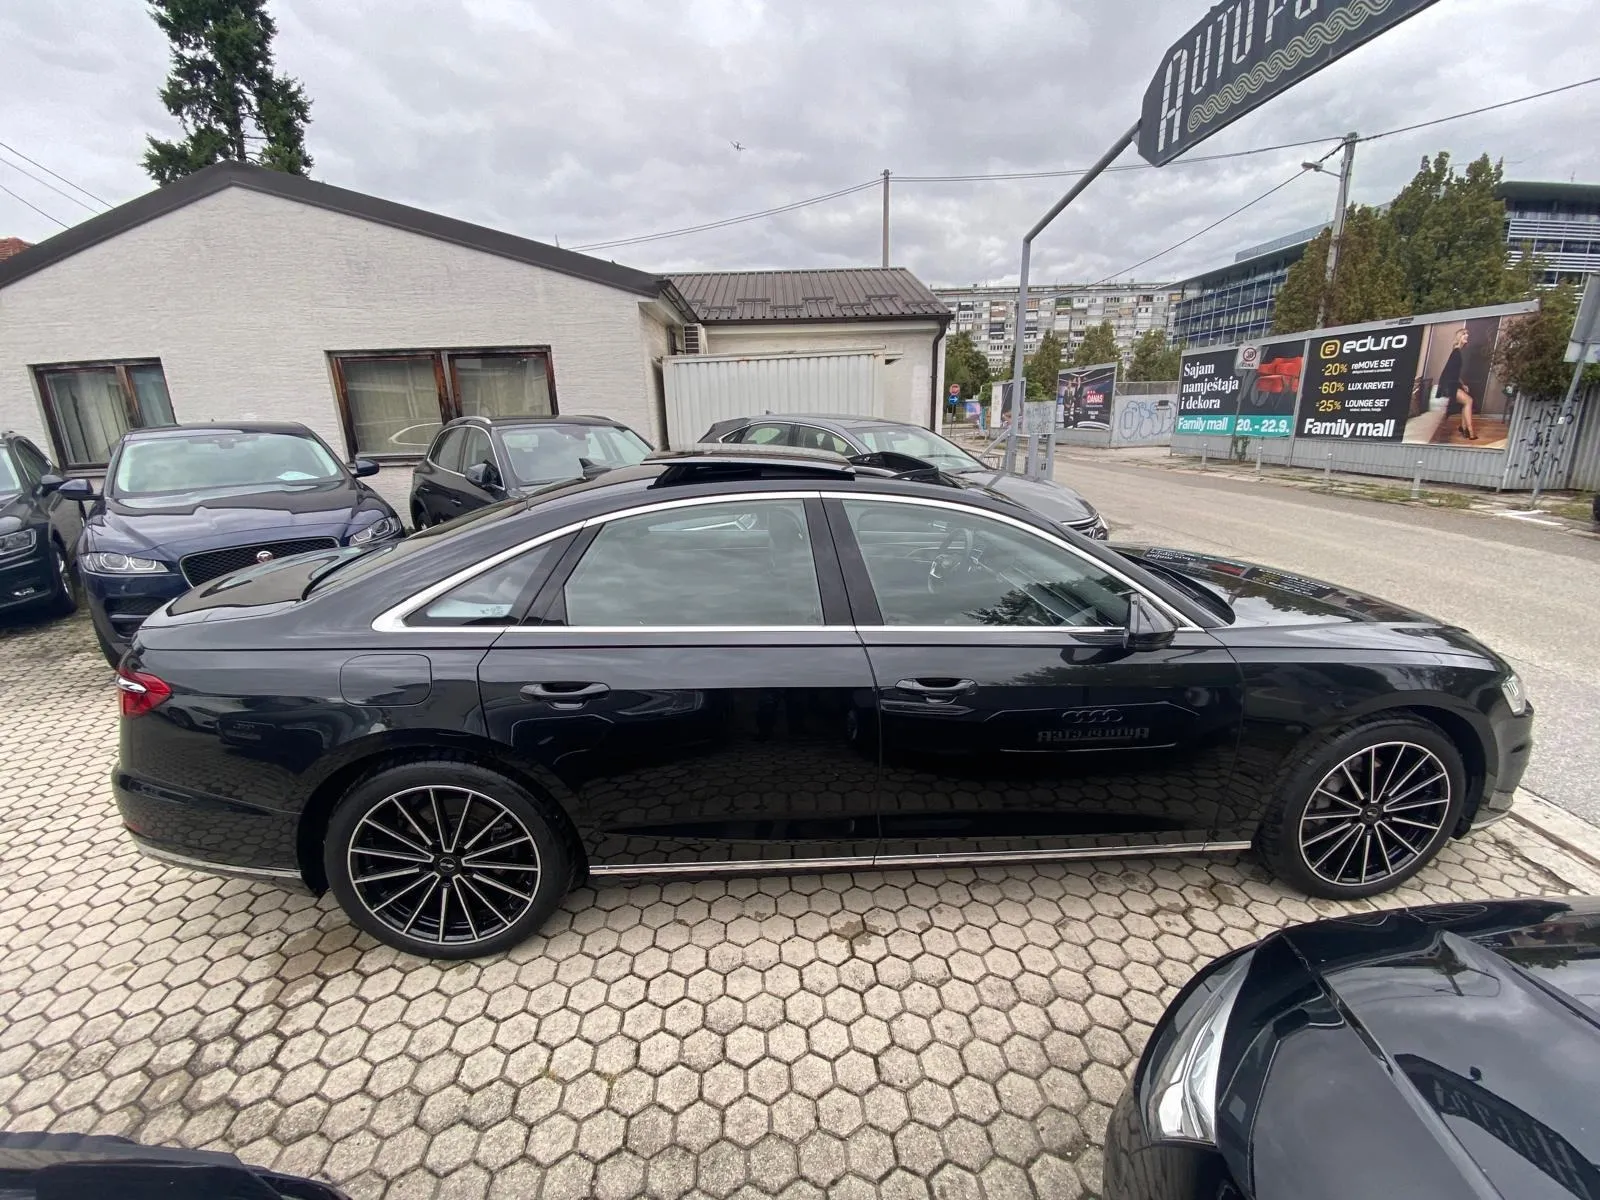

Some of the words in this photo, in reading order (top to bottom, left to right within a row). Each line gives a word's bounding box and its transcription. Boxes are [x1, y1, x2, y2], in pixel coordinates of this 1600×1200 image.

[1342, 334, 1408, 354] eduro
[1183, 361, 1215, 379] Sajam
[1321, 363, 1348, 376] -20%
[1351, 360, 1379, 370] reMOVE
[1379, 358, 1396, 368] SET
[1182, 375, 1239, 394] namještaja
[1318, 381, 1345, 394] -60%
[1347, 382, 1362, 391] LUX
[1362, 381, 1394, 390] KREVETI
[1180, 396, 1185, 410] i
[1186, 395, 1221, 409] dekora
[1345, 399, 1374, 408] LOUNGE
[1374, 398, 1390, 408] SET
[1177, 416, 1206, 431] Family
[1206, 417, 1229, 431] mall
[1235, 418, 1252, 432] 20.
[1260, 419, 1290, 433] 22.9.
[1303, 417, 1355, 438] Family
[1355, 419, 1396, 437] mall
